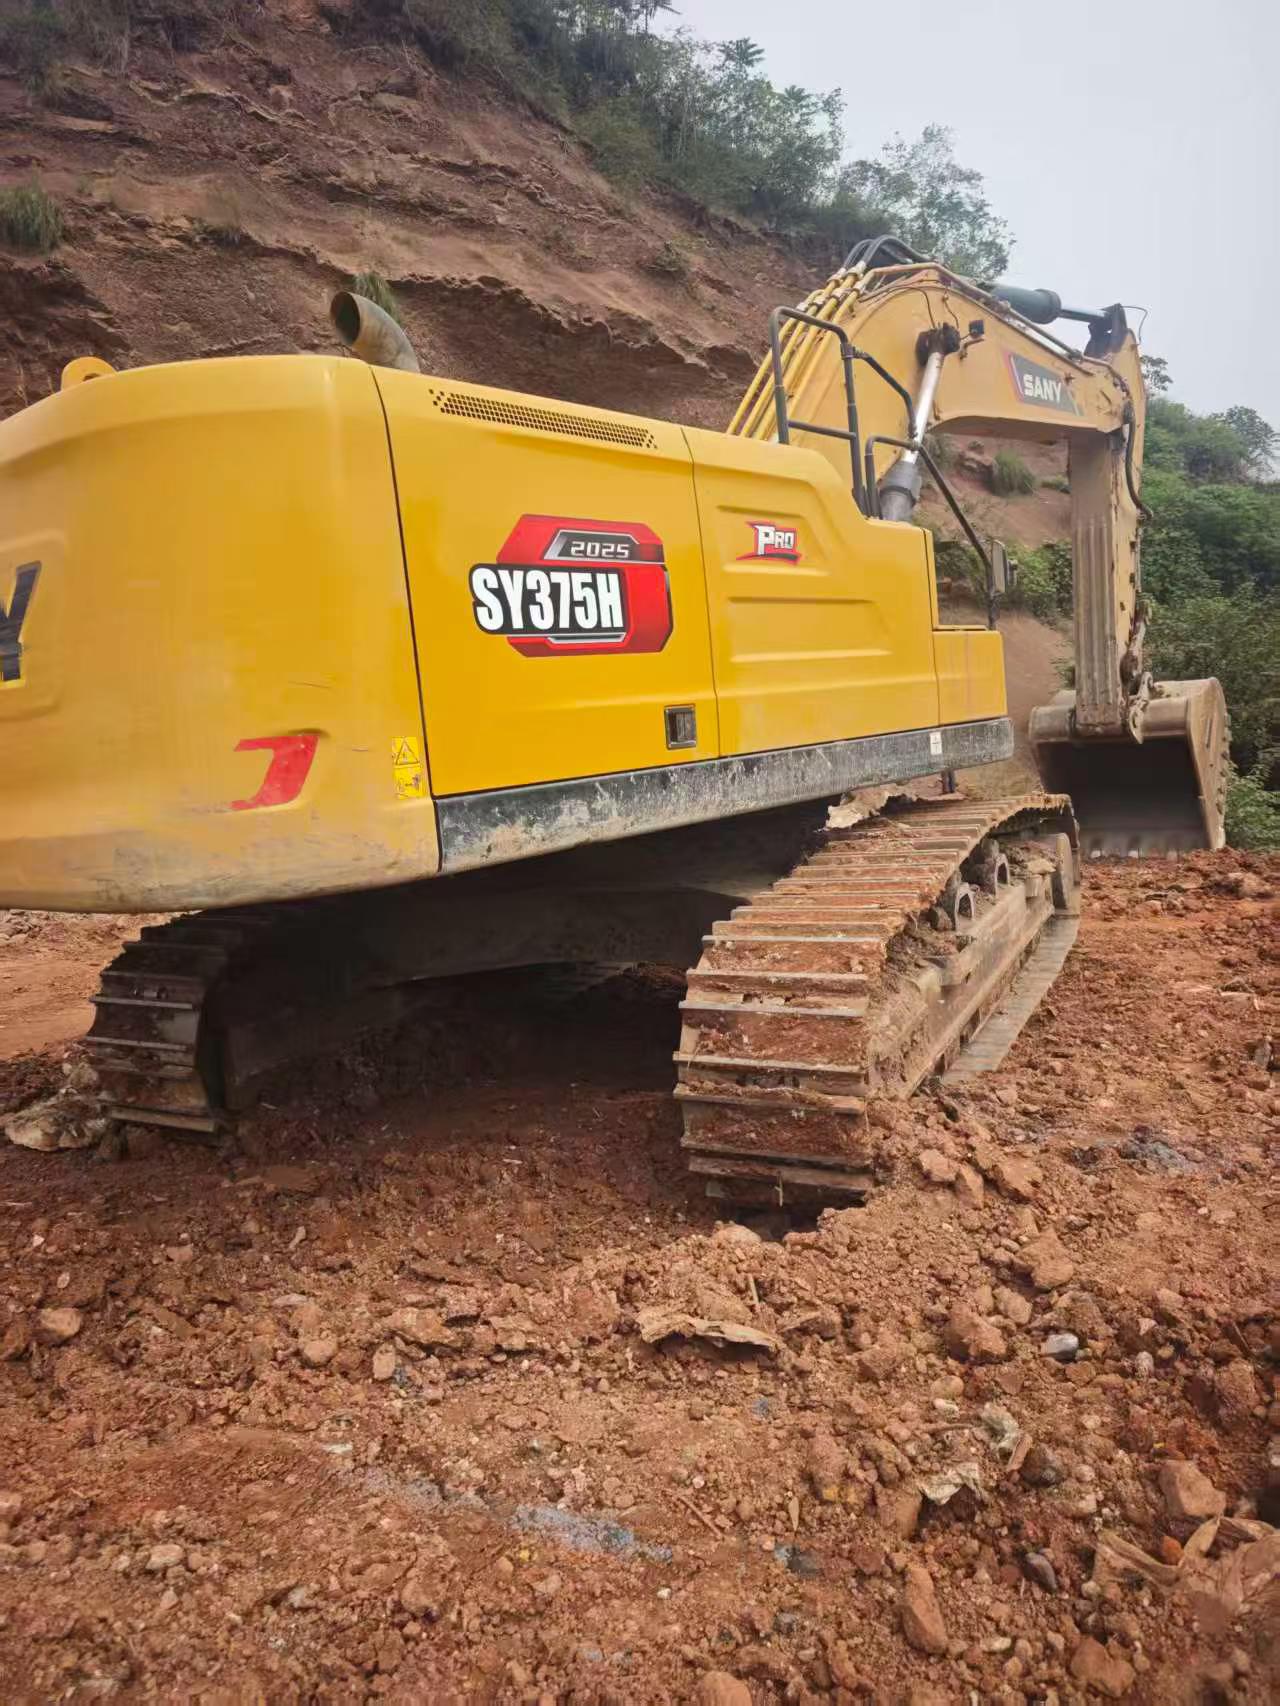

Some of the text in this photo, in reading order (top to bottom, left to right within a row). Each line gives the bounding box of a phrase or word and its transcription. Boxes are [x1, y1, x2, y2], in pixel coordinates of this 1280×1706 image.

[1023, 373, 1062, 404] SANY
[570, 540, 630, 559] 2025
[471, 567, 624, 631] SY375H
